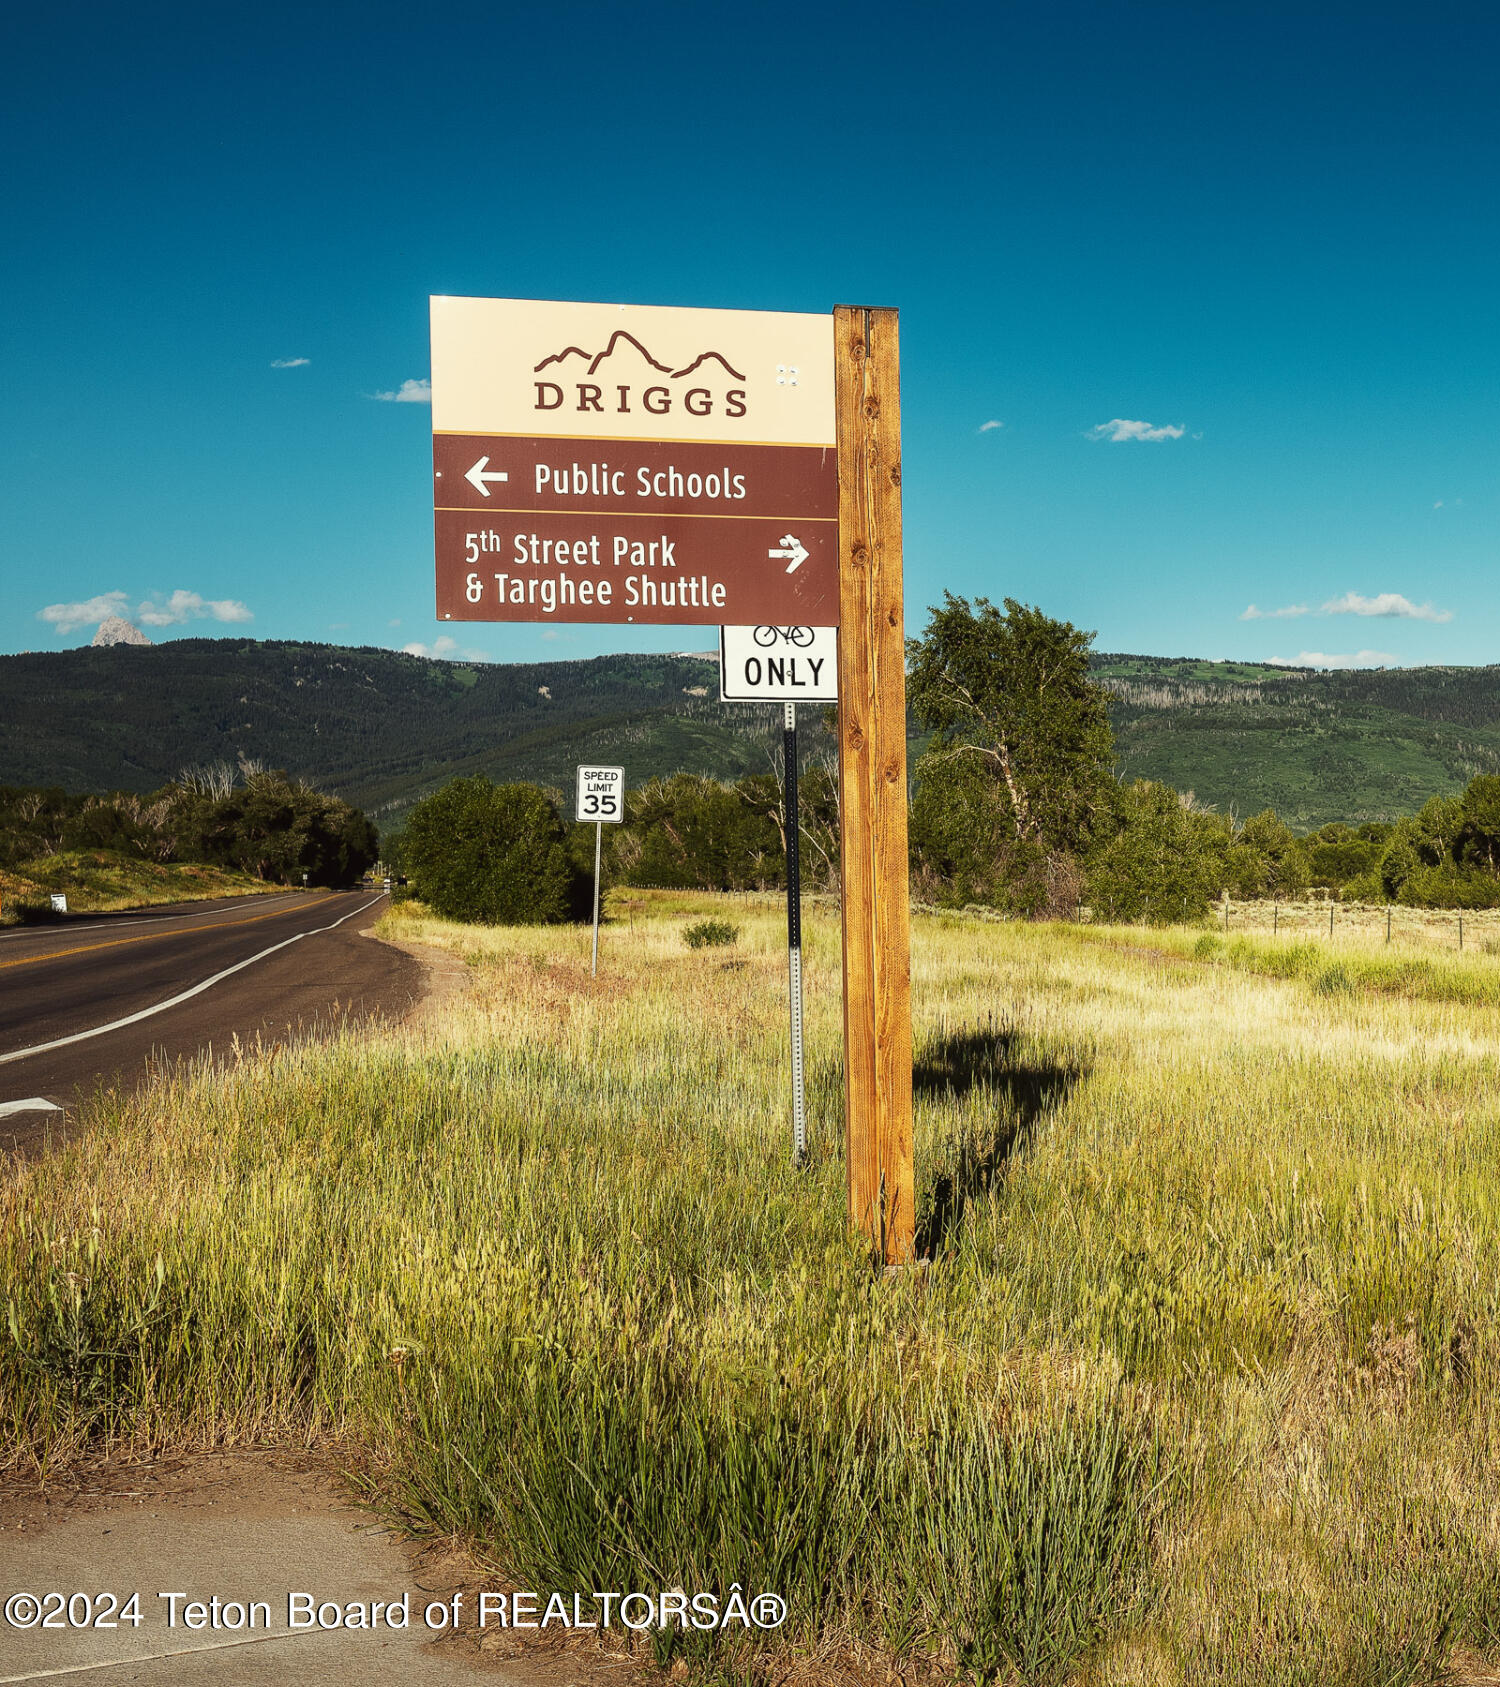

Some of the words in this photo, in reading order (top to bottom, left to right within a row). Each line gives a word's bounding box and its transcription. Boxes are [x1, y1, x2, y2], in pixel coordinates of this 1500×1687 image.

[533, 381, 747, 418] DRIGGS
[535, 462, 626, 496] Public
[636, 465, 746, 499] Schools
[465, 529, 501, 563] 5th
[513, 533, 601, 566] Street
[613, 535, 677, 567] Park
[465, 572, 484, 603] &
[494, 572, 613, 613] Targhee
[624, 574, 727, 608] Shuttle
[744, 656, 825, 687] ONLY
[583, 771, 619, 781] SPEED
[587, 783, 614, 792] LIMIT
[583, 794, 617, 816] 35
